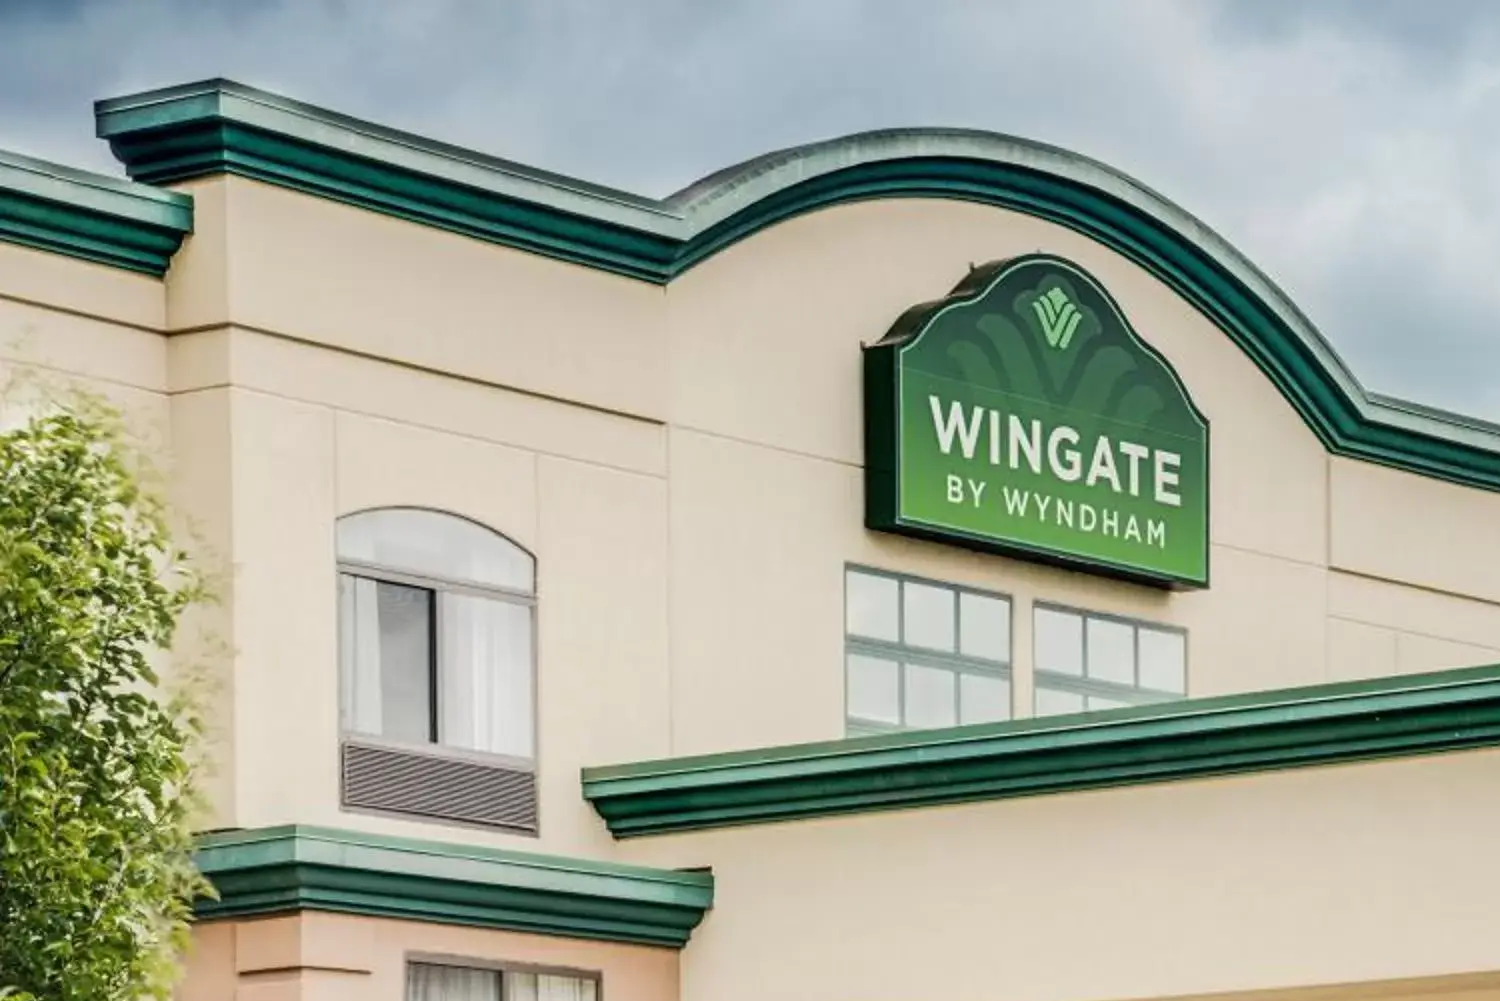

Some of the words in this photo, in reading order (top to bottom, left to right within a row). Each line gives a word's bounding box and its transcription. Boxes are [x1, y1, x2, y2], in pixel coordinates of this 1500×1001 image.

[929, 395, 1181, 506] WINGATE
[946, 475, 986, 508] BY
[1003, 486, 1165, 548] WYNDHAM
